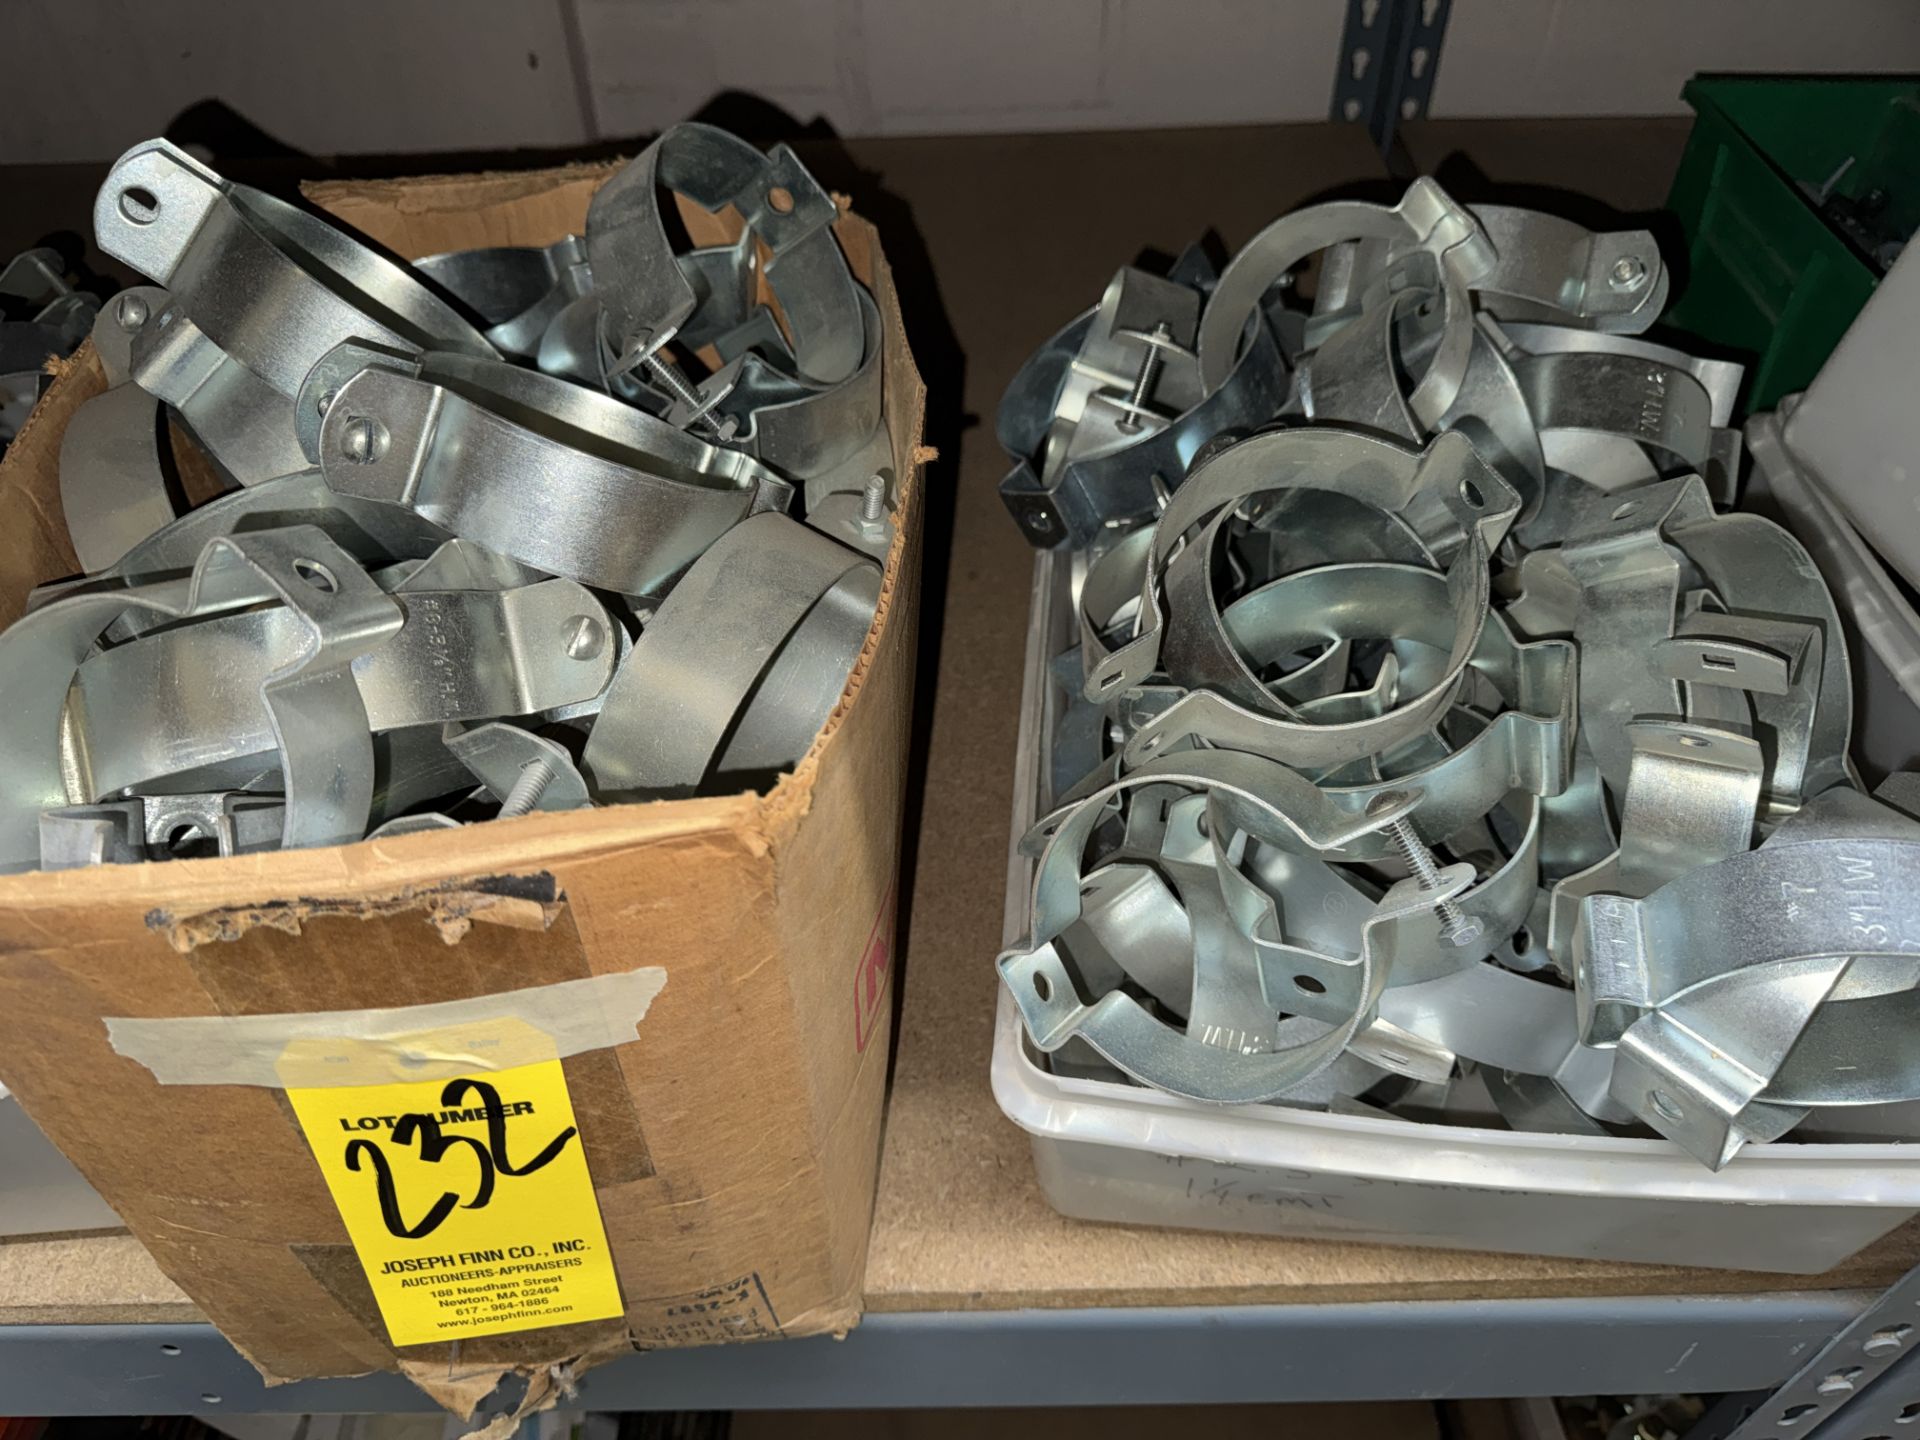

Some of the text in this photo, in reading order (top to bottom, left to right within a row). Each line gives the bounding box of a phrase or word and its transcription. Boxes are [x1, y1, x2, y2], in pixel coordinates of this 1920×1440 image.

[339, 1101, 536, 1132] LOT UMBER
[345, 1078, 577, 1238] 232
[380, 1238, 592, 1275] JOSEPH FINN CO., INC.
[401, 1257, 583, 1288] AUCTIONEERS-APPRAISERS
[430, 1274, 564, 1299] 188 Needham Street
[438, 1285, 560, 1308] Newton, MA 02464
[455, 1305, 478, 1317] 617
[490, 1297, 549, 1312] 964-1886
[436, 1304, 574, 1329] www.josephfinn.com
